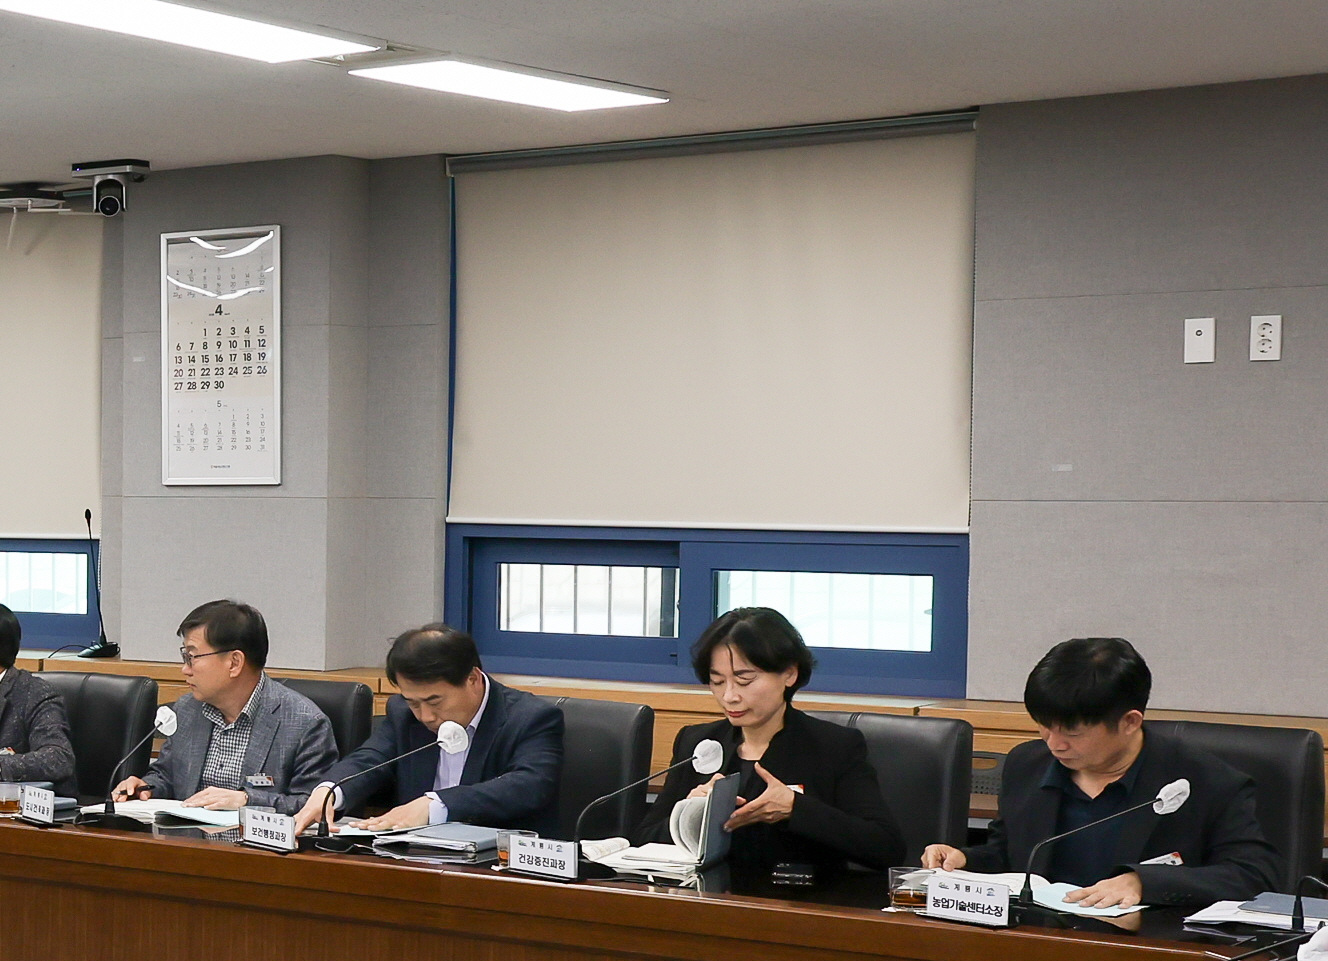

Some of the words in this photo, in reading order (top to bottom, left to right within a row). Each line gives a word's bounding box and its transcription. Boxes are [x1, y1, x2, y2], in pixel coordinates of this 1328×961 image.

[215, 304, 223, 316] 4
[203, 328, 207, 337] 1
[216, 327, 222, 336] 2
[230, 326, 236, 336] 3
[244, 326, 250, 335] 4
[259, 325, 265, 334] 5
[176, 342, 181, 351] 6
[189, 342, 195, 351] 7
[202, 341, 208, 350] 8
[216, 340, 222, 349] 9
[229, 340, 237, 349] 10
[244, 339, 250, 348] 11
[258, 338, 266, 348] 12
[175, 356, 183, 365] 13
[188, 355, 196, 364] 14
[201, 354, 209, 363] 15
[215, 354, 223, 363] 16
[229, 353, 237, 362] 17
[243, 352, 252, 361] 18
[258, 352, 266, 361] 19
[174, 368, 183, 377] 20
[188, 368, 196, 377] 21
[201, 367, 210, 376] 22
[214, 367, 224, 376] 23
[228, 366, 238, 375] 24
[243, 366, 252, 375] 25
[257, 365, 267, 375] 26
[174, 381, 183, 391] 27
[187, 381, 197, 390] 28
[201, 380, 210, 390] 29
[214, 380, 224, 389] 30
[217, 400, 222, 408] 5
[518, 853, 566, 870] 건강증진과장
[932, 896, 1004, 917] 농업기술센터소장
